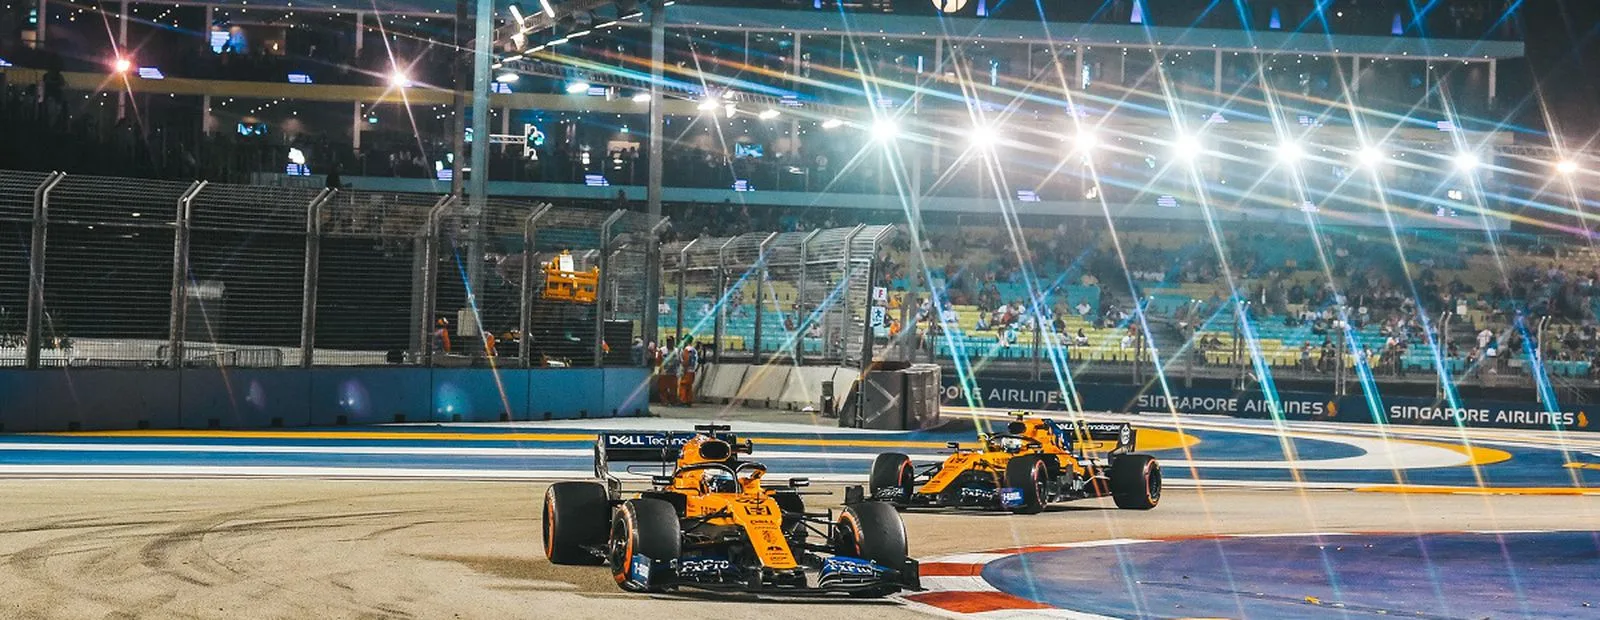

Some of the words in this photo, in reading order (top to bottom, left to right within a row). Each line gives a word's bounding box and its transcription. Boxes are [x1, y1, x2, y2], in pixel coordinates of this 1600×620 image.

[988, 388, 1069, 404] AIRLINES
[1137, 395, 1238, 412] SINGAPORE
[1244, 399, 1324, 415] AIRLINES
[1390, 405, 1490, 422] SINGAPORE
[1495, 409, 1574, 425] AIRLINES
[609, 435, 645, 445] DELL
